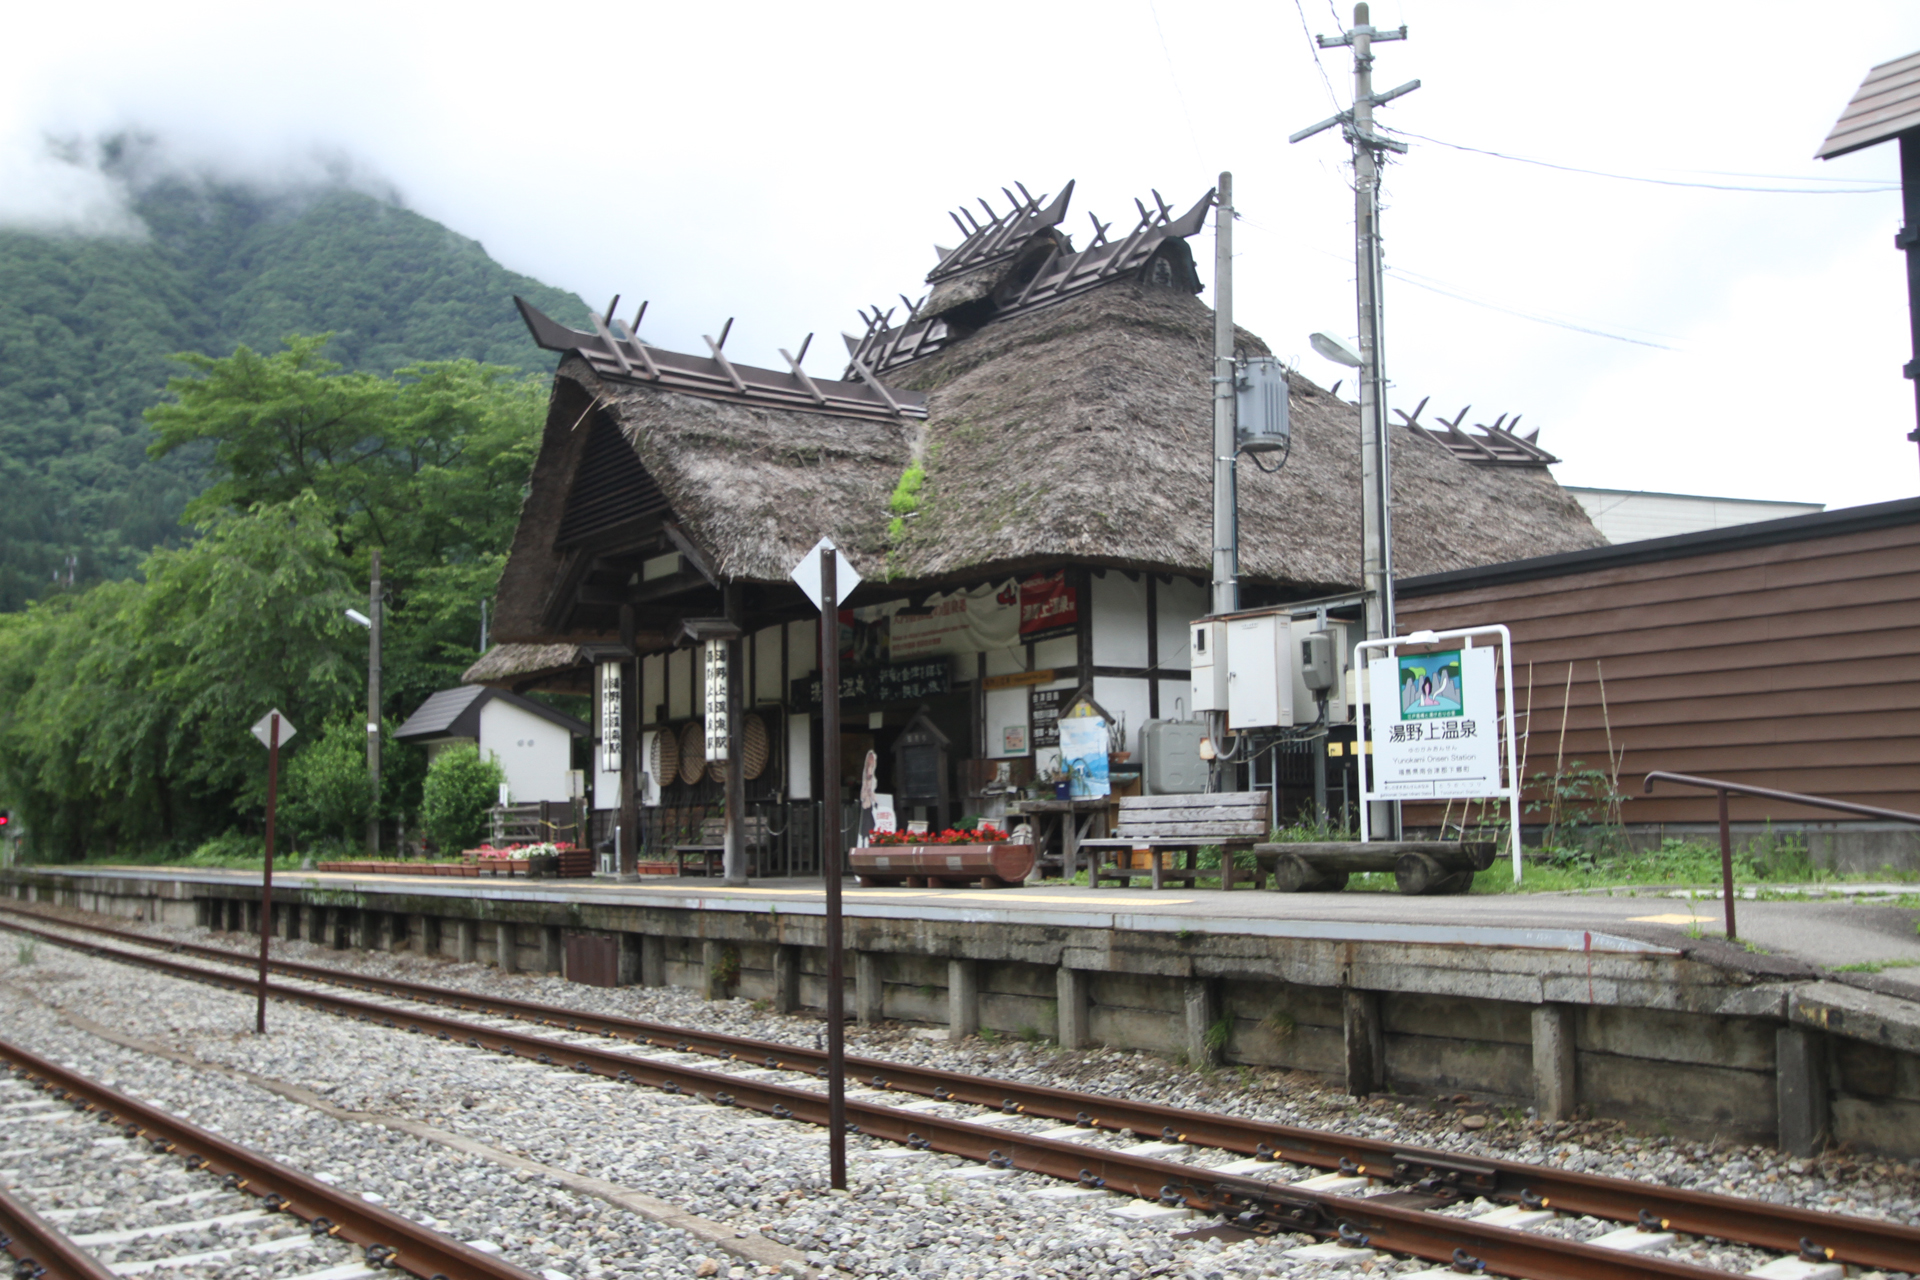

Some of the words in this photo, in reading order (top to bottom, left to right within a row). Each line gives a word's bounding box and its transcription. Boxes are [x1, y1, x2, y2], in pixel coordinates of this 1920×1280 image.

[1389, 719, 1478, 743] 湯野上温泉
[1408, 745, 1457, 753] ゆのかみおんせん
[1393, 756, 1425, 765] Yunokami
[1427, 755, 1449, 763] Onsen
[1451, 753, 1476, 762] Station
